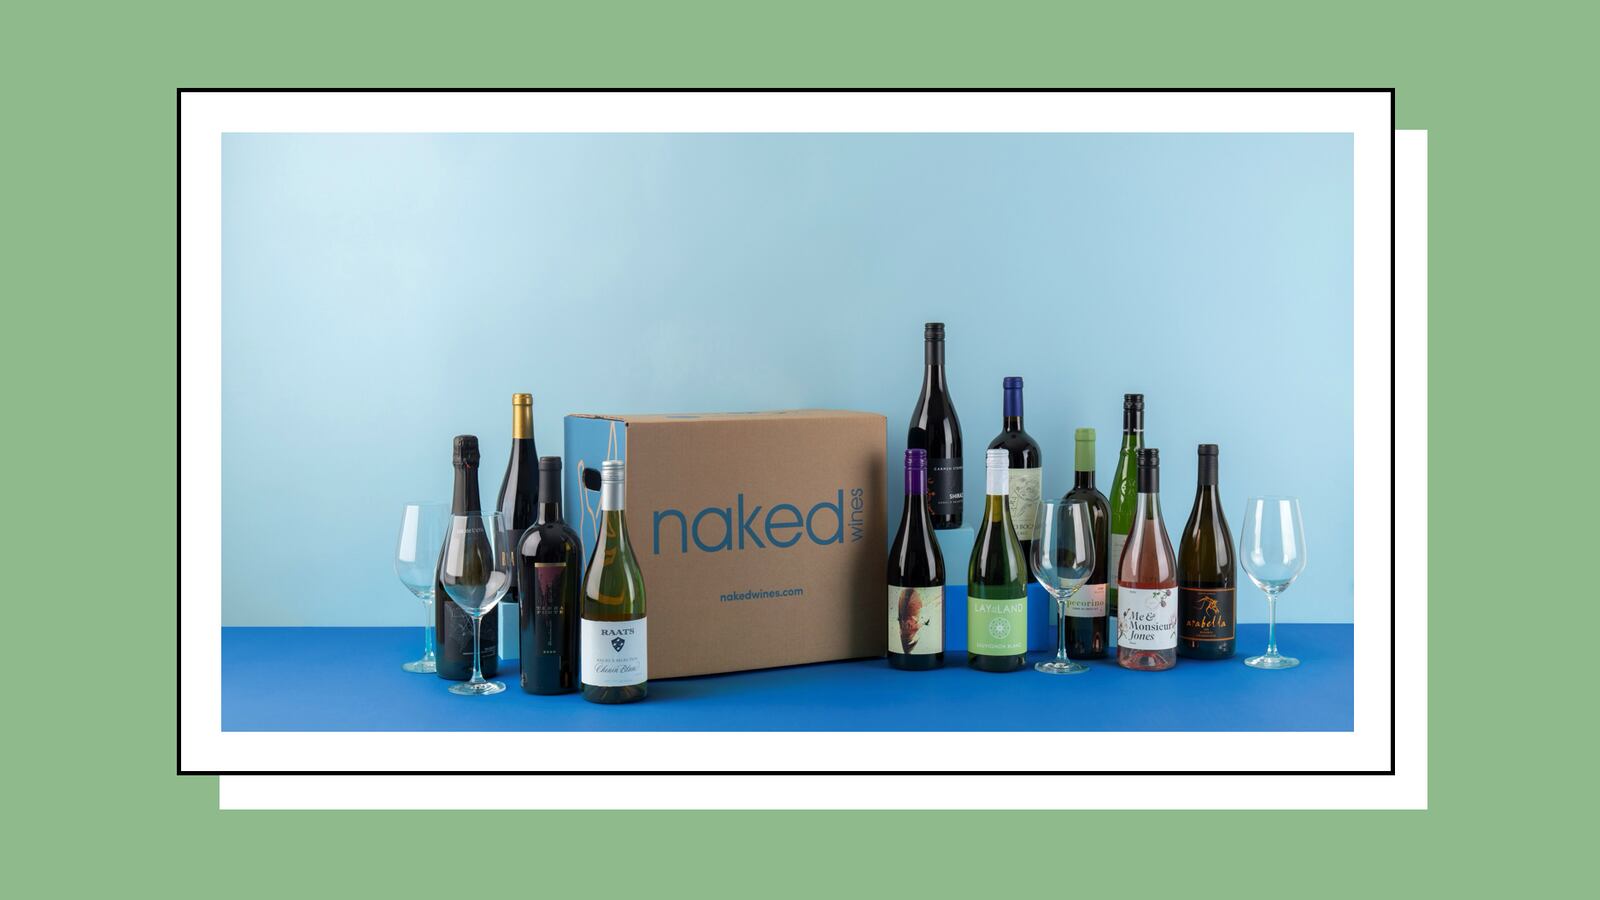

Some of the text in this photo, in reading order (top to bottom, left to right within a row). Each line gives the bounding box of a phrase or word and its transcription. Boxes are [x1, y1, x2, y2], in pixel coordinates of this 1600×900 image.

[848, 488, 864, 543] wines
[653, 489, 844, 554] naked
[720, 587, 804, 602] nakedwines.com
[975, 604, 991, 613] LAY
[998, 603, 1024, 614] LAND
[1066, 599, 1104, 608] pecorino
[1129, 611, 1156, 621] Me &
[1186, 615, 1227, 628] arabella
[1129, 621, 1172, 631] Monsieur
[601, 628, 635, 636] RAATS
[1128, 630, 1155, 641] Jones
